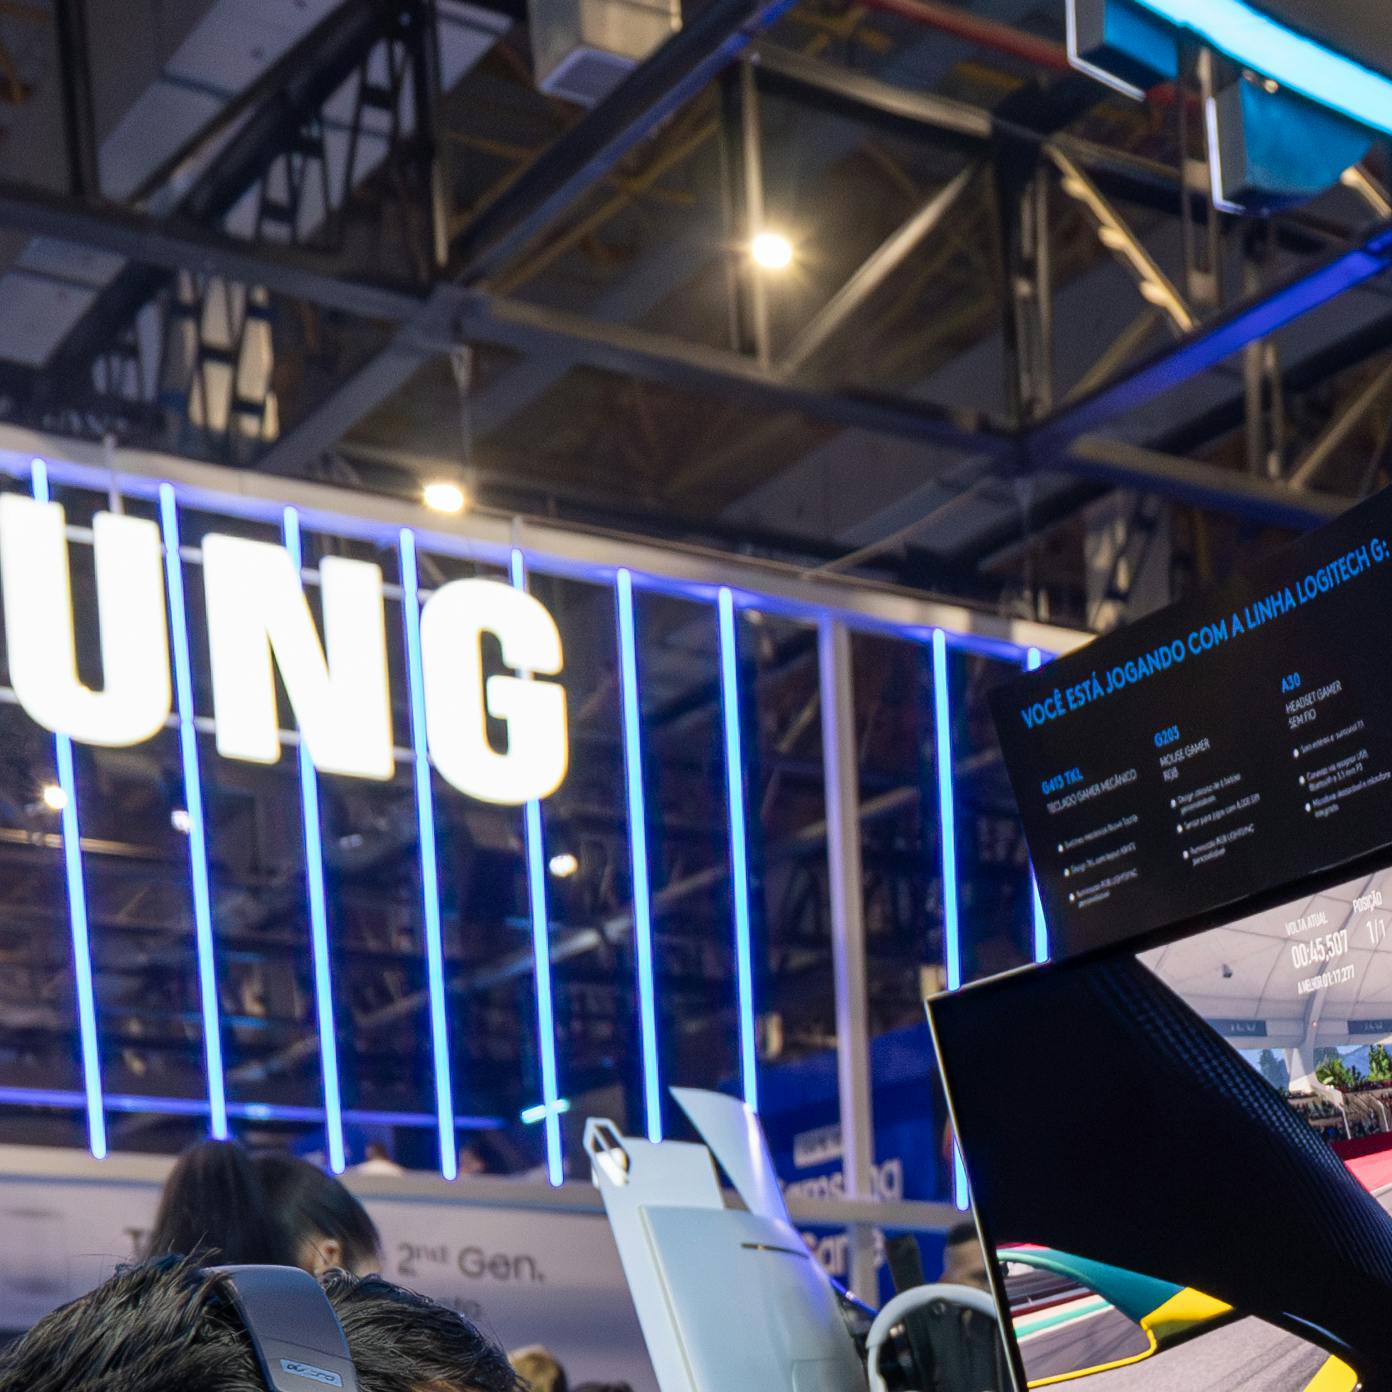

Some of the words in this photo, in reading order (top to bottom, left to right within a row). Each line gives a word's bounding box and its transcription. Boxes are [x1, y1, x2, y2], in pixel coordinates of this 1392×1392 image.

[1020, 686, 1066, 730] VOCÊ
[1066, 670, 1105, 711] ESTÁ
[1104, 638, 1187, 695] JOGANDO
[1187, 618, 1229, 657] COM
[1231, 611, 1245, 639] A
[1245, 586, 1297, 631] LINHA
[1296, 545, 1370, 606] LOGITECH
[1369, 535, 1391, 563] G:
[1280, 671, 1302, 694] A30
[456, 1246, 546, 1284] Gen.
